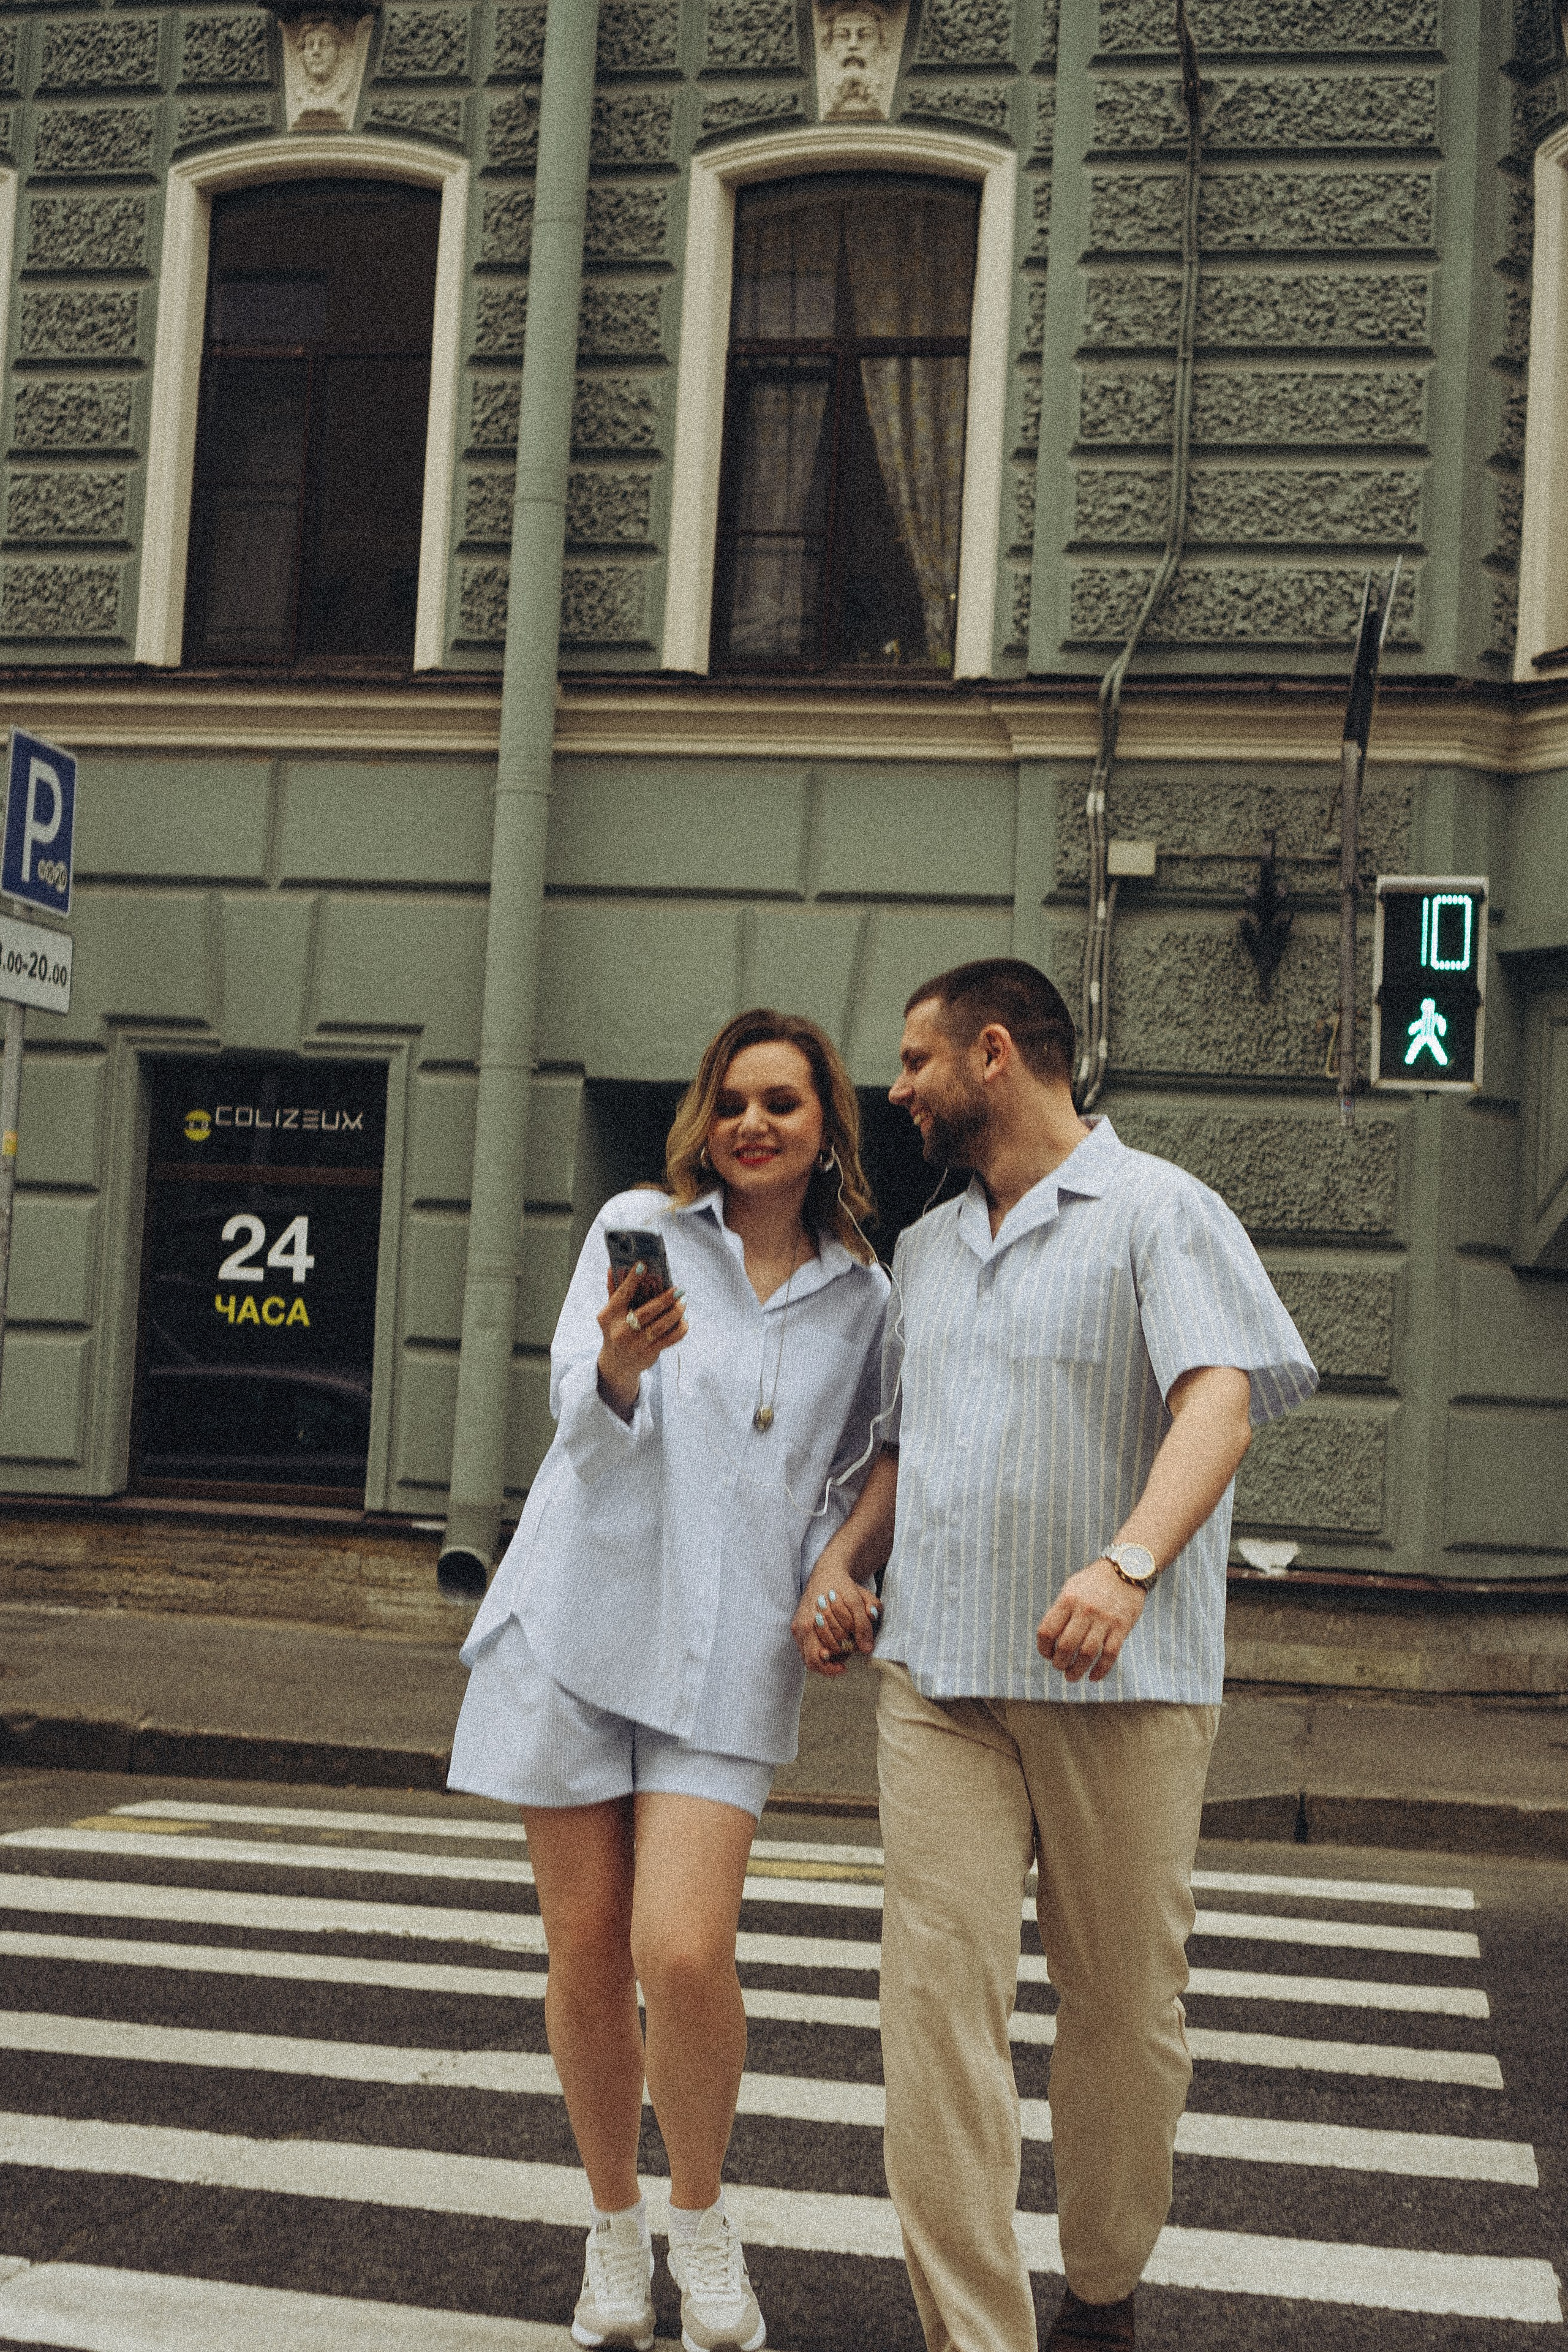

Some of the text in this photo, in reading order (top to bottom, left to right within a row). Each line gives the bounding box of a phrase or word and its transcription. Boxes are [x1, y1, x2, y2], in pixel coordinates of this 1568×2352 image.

[21, 757, 61, 882] P
[1421, 895, 1472, 970] 10
[216, 1106, 363, 1130] COLIZEUM
[217, 1214, 314, 1283] 24
[214, 1294, 310, 1327] ЧАСА
